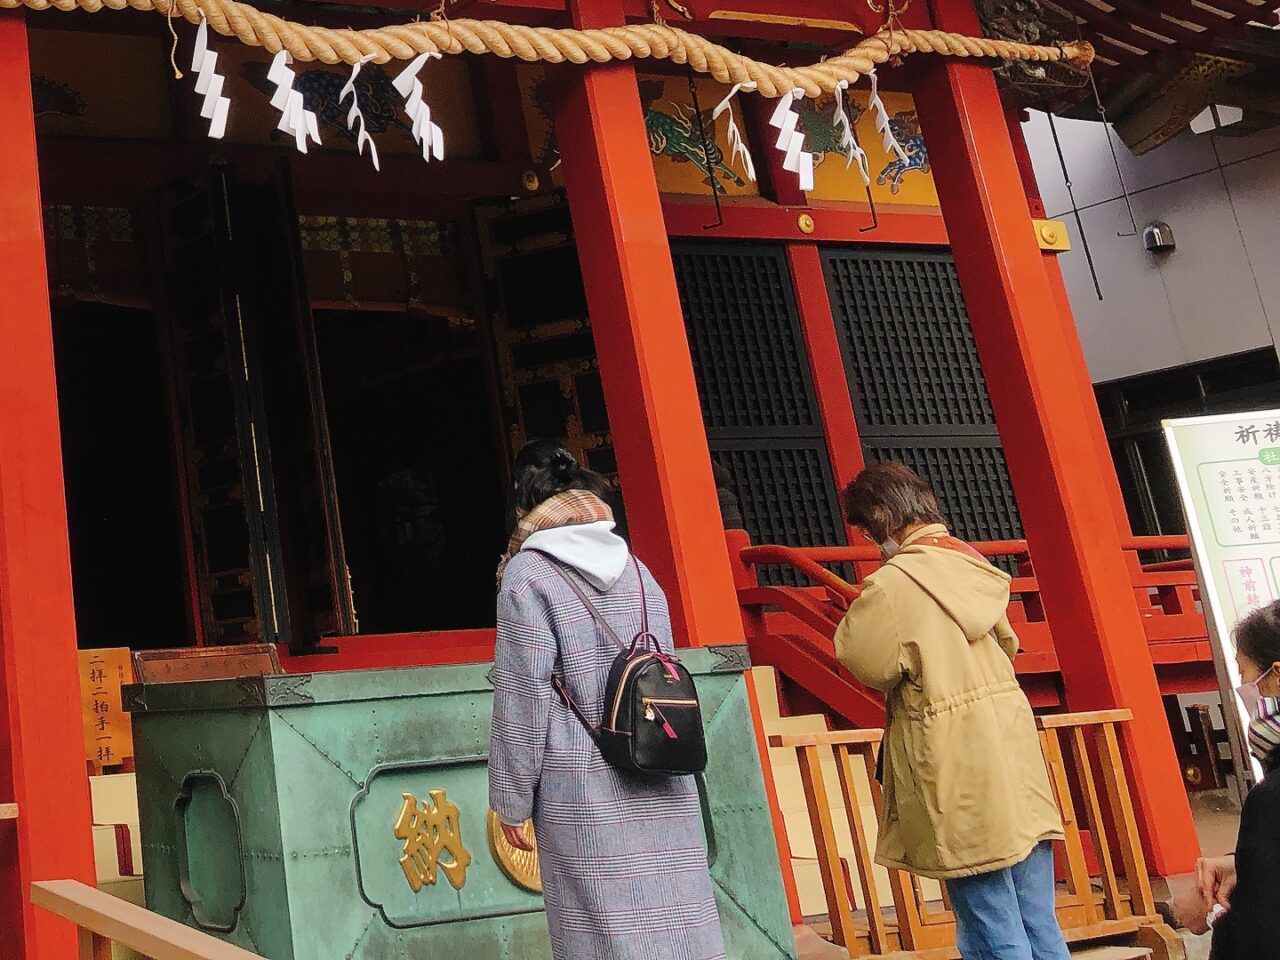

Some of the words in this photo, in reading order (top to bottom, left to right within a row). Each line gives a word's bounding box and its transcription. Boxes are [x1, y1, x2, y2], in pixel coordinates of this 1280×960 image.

[89, 655, 114, 761] 二拝二拍手一拝
